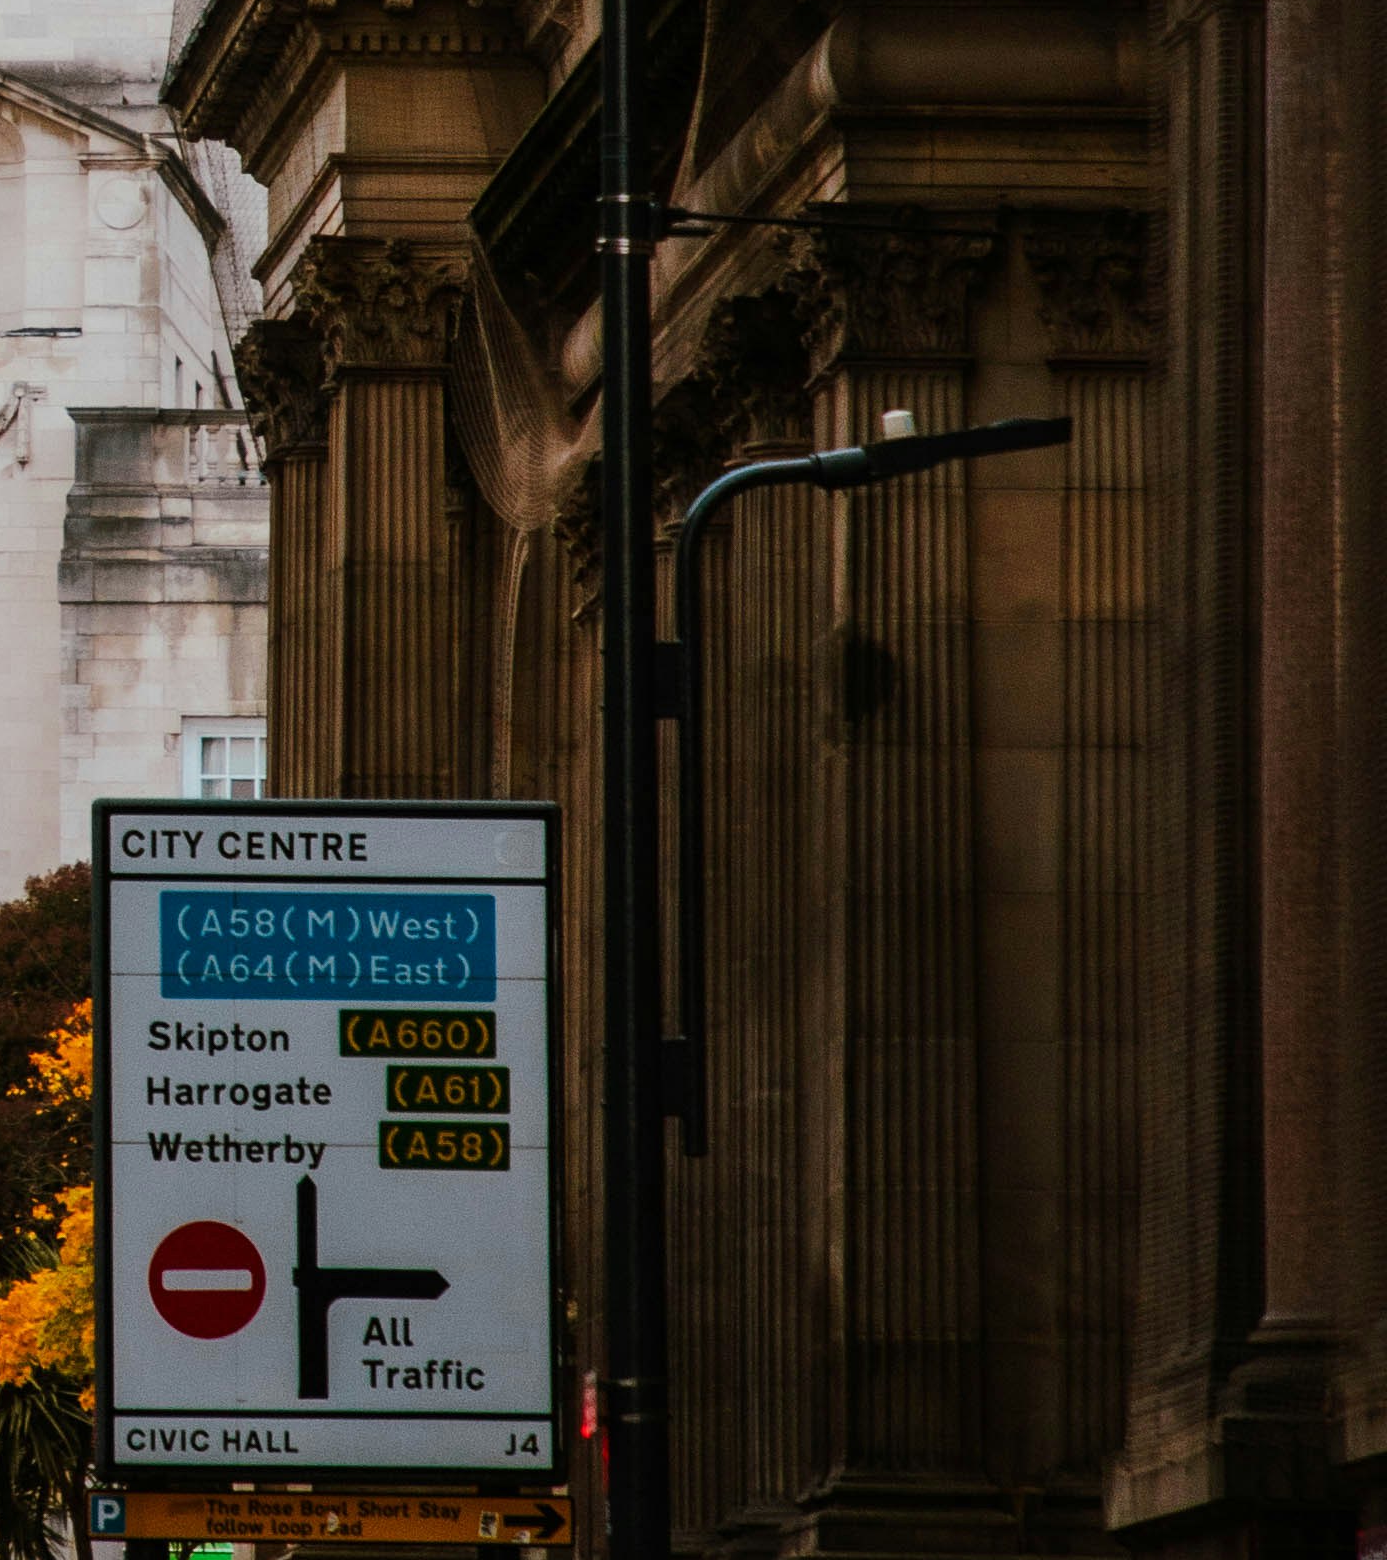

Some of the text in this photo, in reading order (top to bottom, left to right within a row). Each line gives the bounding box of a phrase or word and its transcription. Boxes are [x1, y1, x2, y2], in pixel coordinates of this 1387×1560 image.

[121, 829, 368, 862] CITY CENTRE
[146, 1015, 490, 1057] Skipton (A660)
[146, 1071, 502, 1111] Harrogate (A61)
[147, 1126, 504, 1170] Wetherby (A58)
[362, 1316, 414, 1347] All
[362, 1358, 485, 1391] Traffic
[126, 1428, 540, 1457] CIVIC HALL J4
[96, 1498, 121, 1531] P
[207, 1498, 241, 1516] The
[248, 1498, 293, 1517] Rose
[358, 1500, 411, 1519] Short
[419, 1501, 462, 1522] Stay
[206, 1518, 363, 1538] follow loop rad
